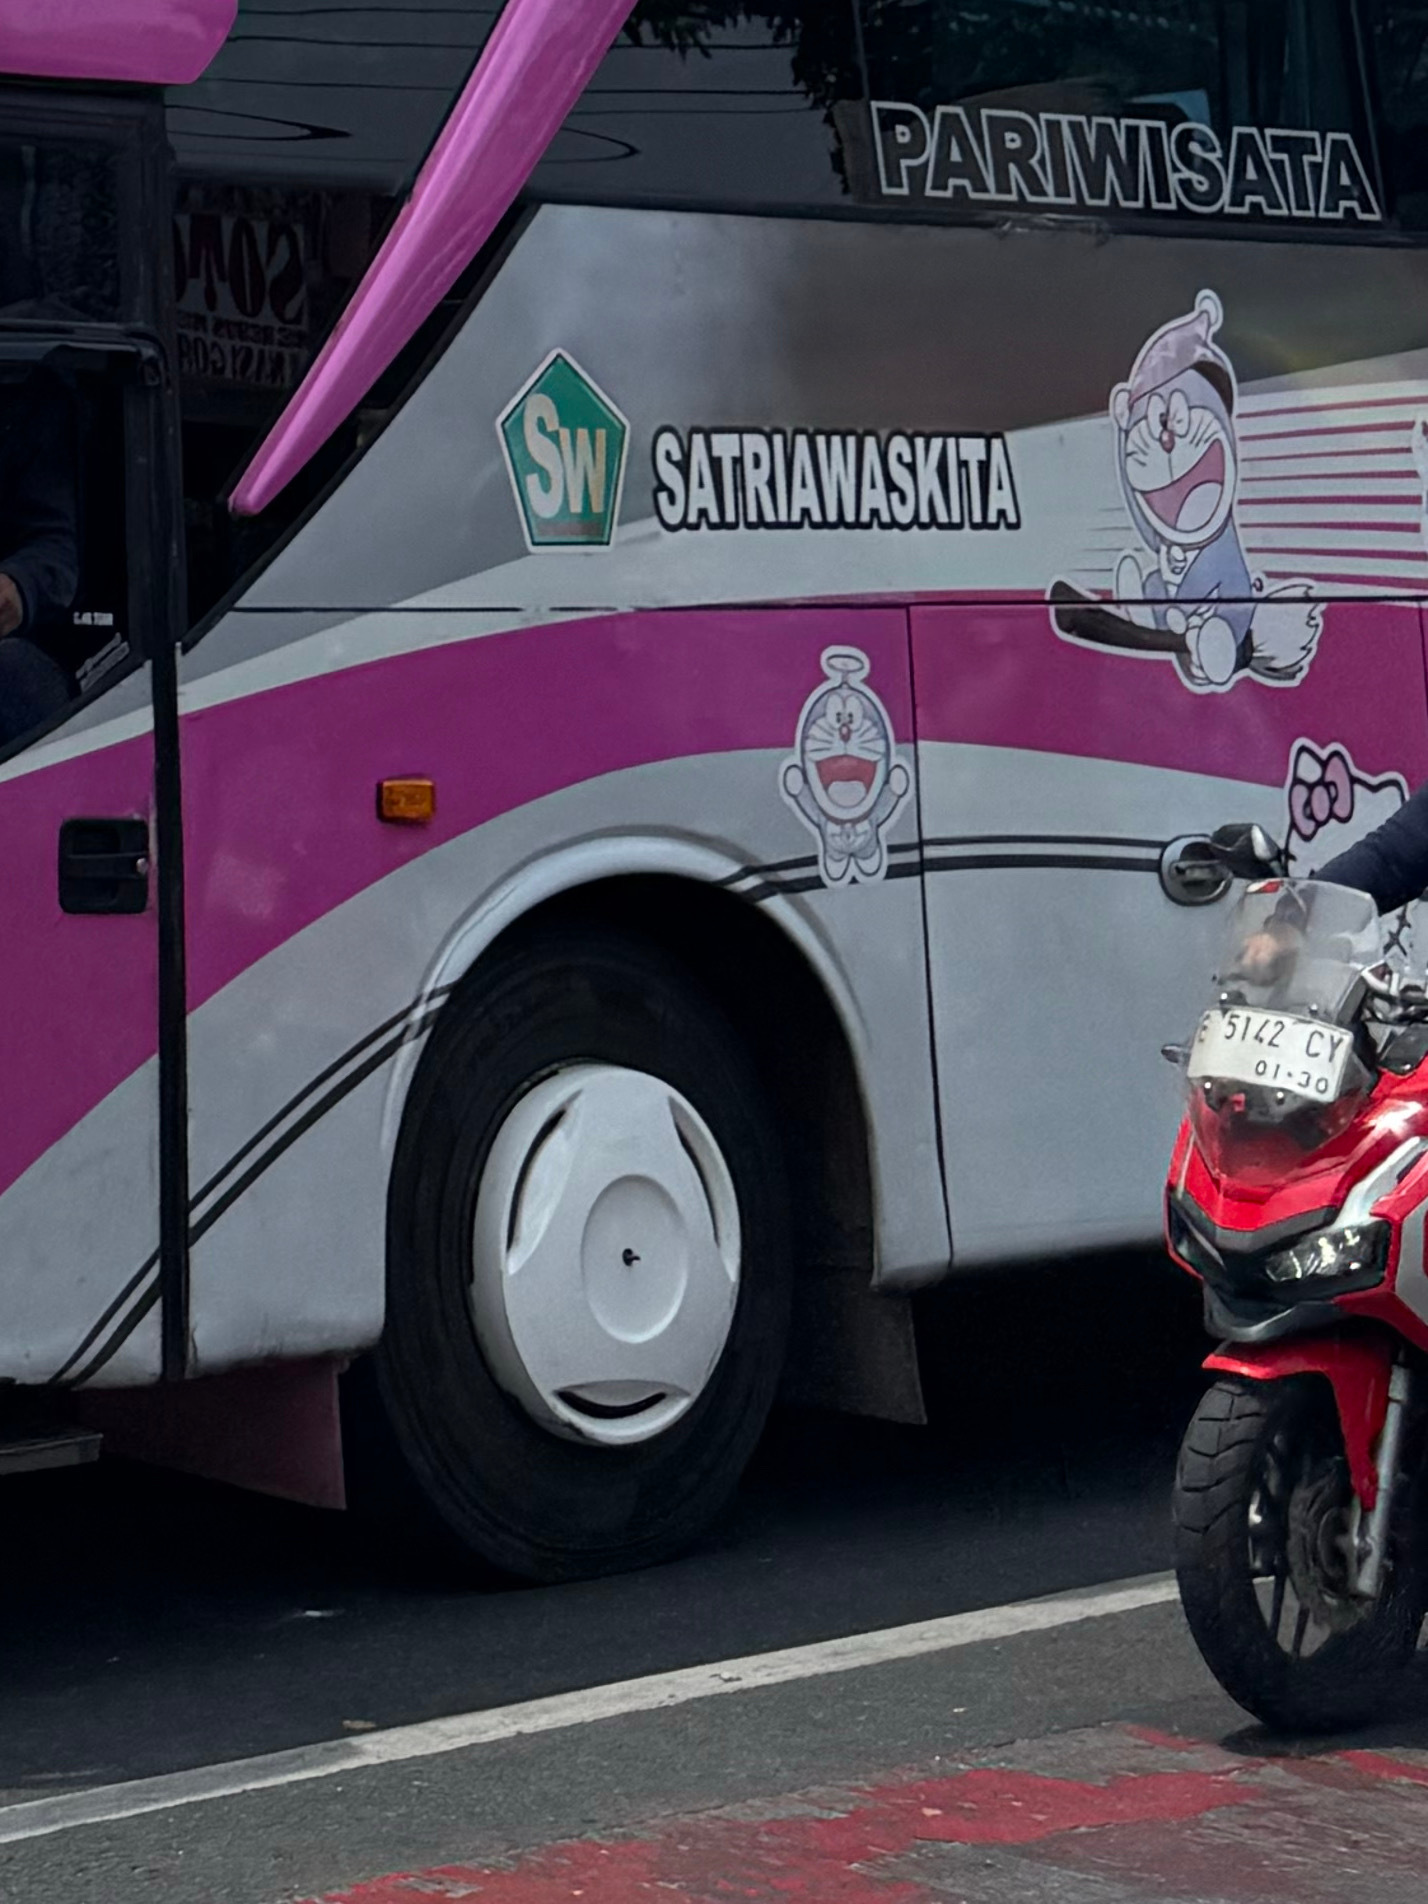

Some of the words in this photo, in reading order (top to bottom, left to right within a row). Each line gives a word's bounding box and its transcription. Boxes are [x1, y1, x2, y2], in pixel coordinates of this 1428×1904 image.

[870, 100, 1382, 221] PARIWISATA
[523, 393, 607, 519] SW
[654, 428, 1020, 530] SATRIAWASKITA
[1224, 1013, 1286, 1048] 5142
[1305, 1029, 1344, 1064] CY
